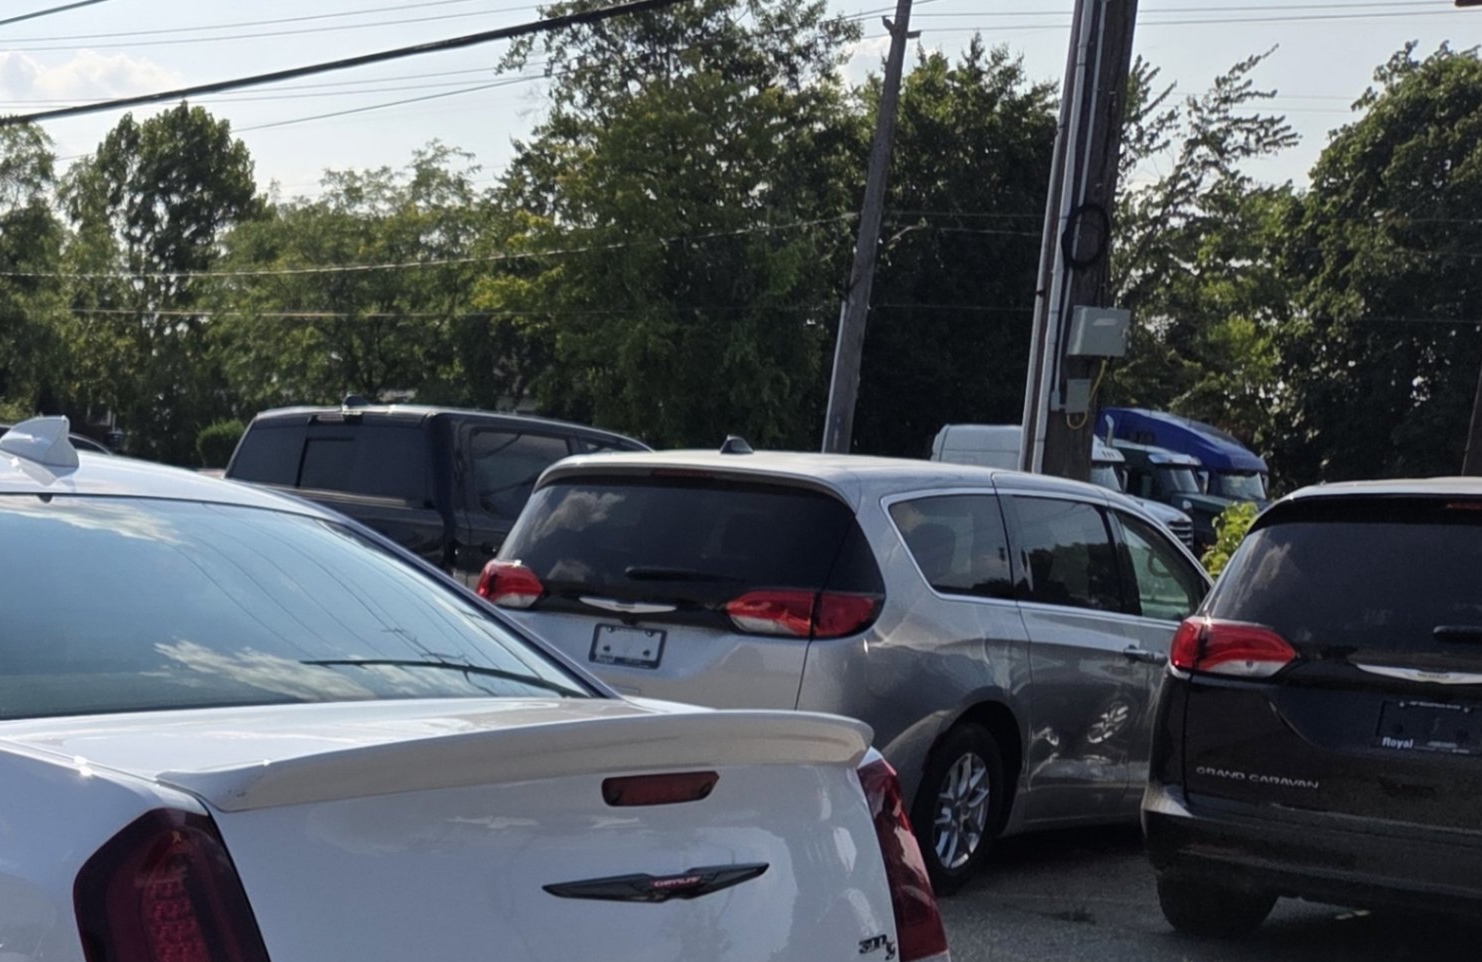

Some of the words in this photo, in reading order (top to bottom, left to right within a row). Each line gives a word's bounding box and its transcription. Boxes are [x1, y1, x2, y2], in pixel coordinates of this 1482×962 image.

[1382, 736, 1413, 749] Royal
[1196, 766, 1245, 780] GRAND
[1249, 773, 1318, 789] CARAVAN
